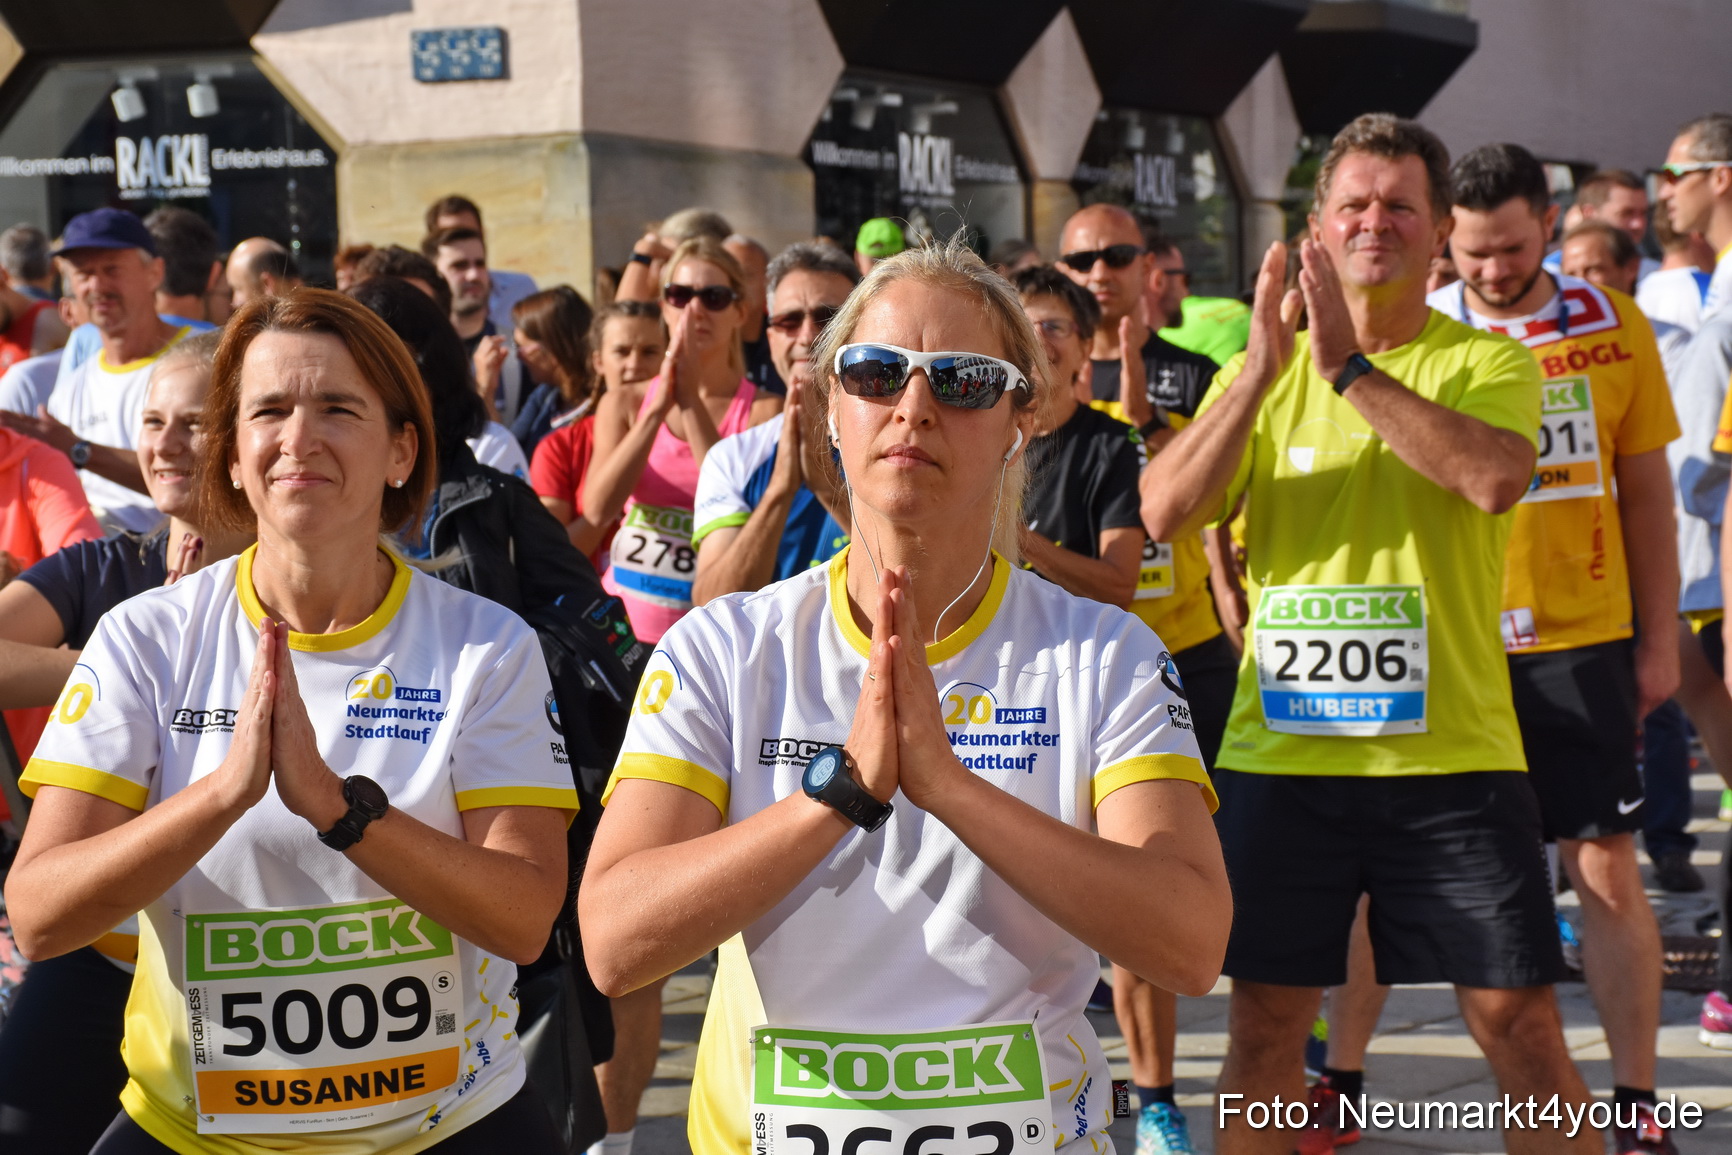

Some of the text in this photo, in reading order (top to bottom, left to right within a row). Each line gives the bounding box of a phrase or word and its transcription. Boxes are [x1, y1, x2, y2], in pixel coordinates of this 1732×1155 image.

[116, 134, 211, 188] RACKL
[898, 132, 955, 195] RACKL
[1542, 342, 1632, 377] BÖGL
[1266, 592, 1411, 625] BOCK
[1275, 639, 1407, 682] 2206
[350, 673, 438, 700] 20 JAHRE
[944, 694, 1042, 725] 20 JAHRE
[1289, 697, 1394, 718] HUBERT
[345, 725, 431, 744] Stadtlauf
[204, 908, 436, 972] BOCK
[438, 976, 449, 988] S
[221, 976, 431, 1056] 5009
[774, 1034, 1025, 1099] BOCK
[234, 1063, 426, 1107] SUSANNE
[1026, 1124, 1039, 1138] D
